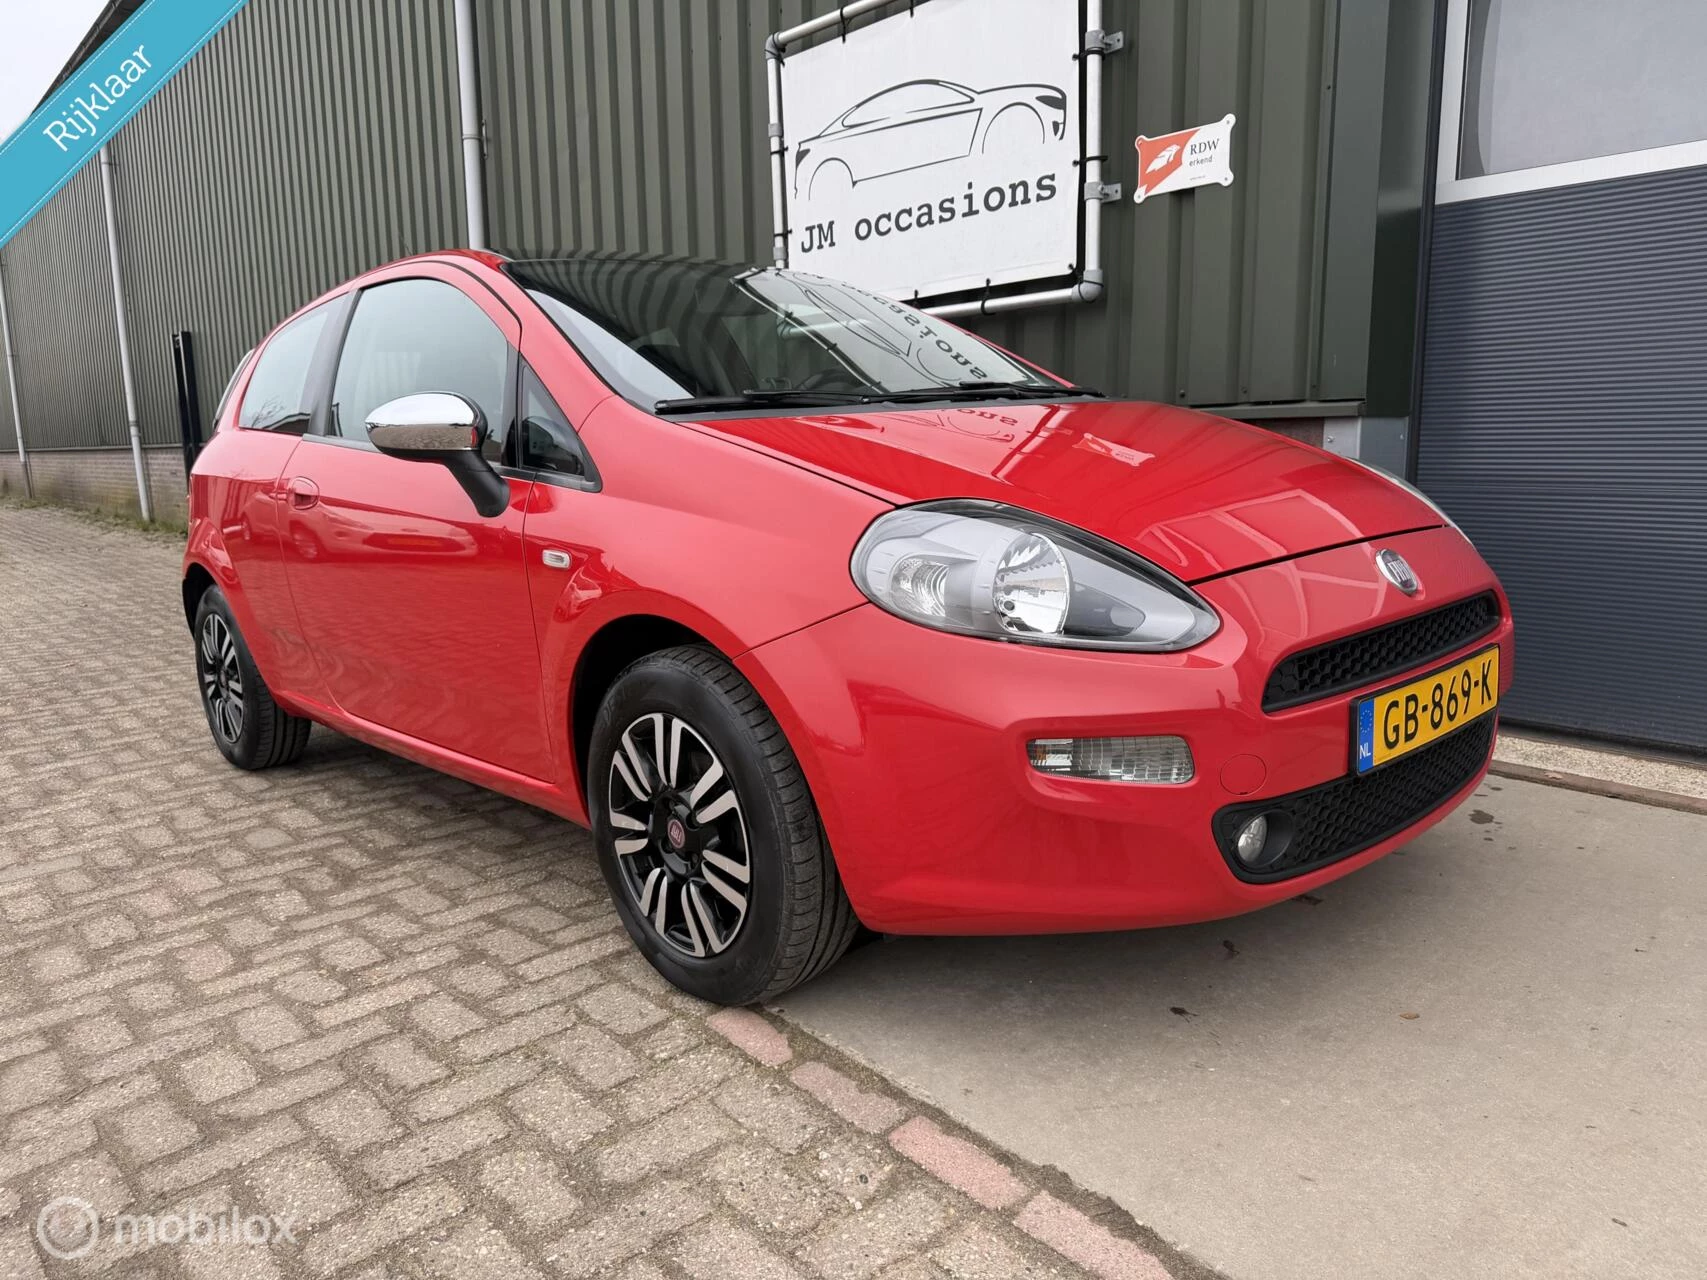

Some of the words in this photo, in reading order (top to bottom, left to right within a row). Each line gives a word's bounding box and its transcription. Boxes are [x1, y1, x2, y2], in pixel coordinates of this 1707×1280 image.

[1189, 138, 1220, 156] RDW
[1189, 155, 1213, 167] erkend
[801, 221, 836, 253] JM
[854, 173, 1057, 241] occasions
[1383, 659, 1492, 750] GB-869-K
[1359, 742, 1371, 760] NL
